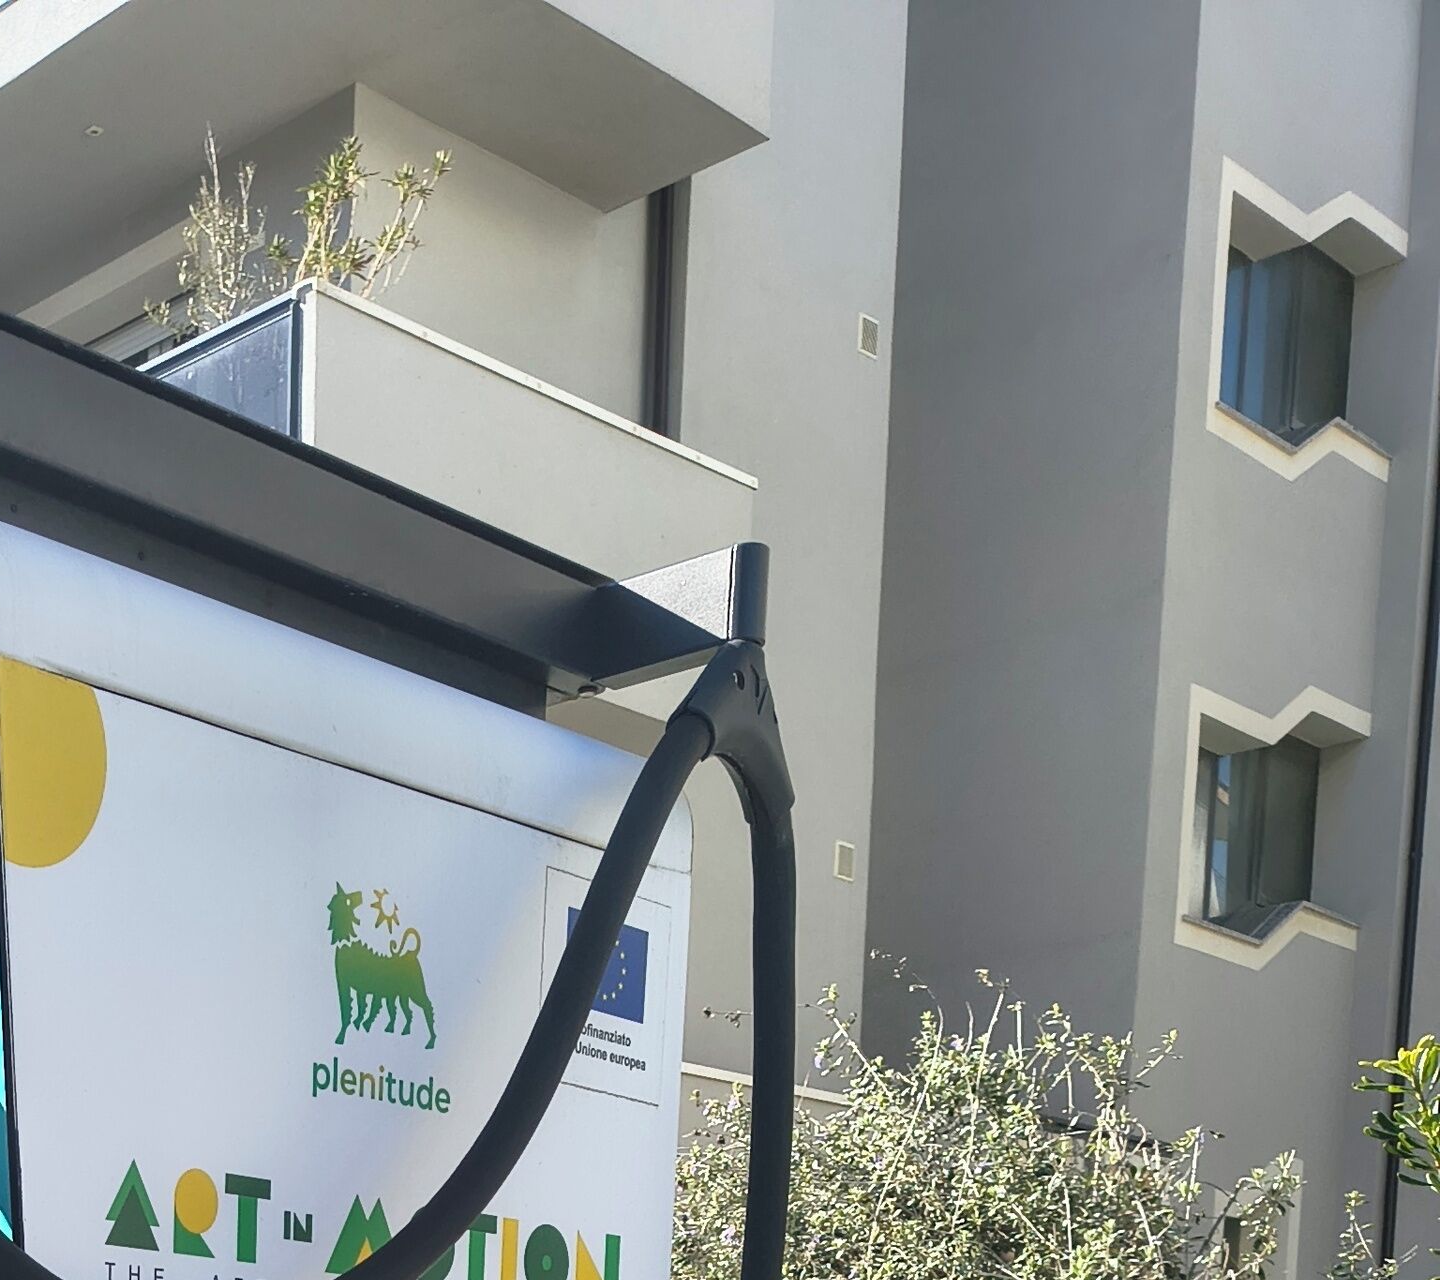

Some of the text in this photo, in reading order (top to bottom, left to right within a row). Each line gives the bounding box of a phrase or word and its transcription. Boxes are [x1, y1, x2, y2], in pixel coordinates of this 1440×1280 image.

[581, 1023, 632, 1047] ofinanziato
[609, 1051, 647, 1072] europea
[312, 1057, 451, 1114] plenitude
[104, 1158, 272, 1265] ART
[283, 1210, 313, 1243] IN
